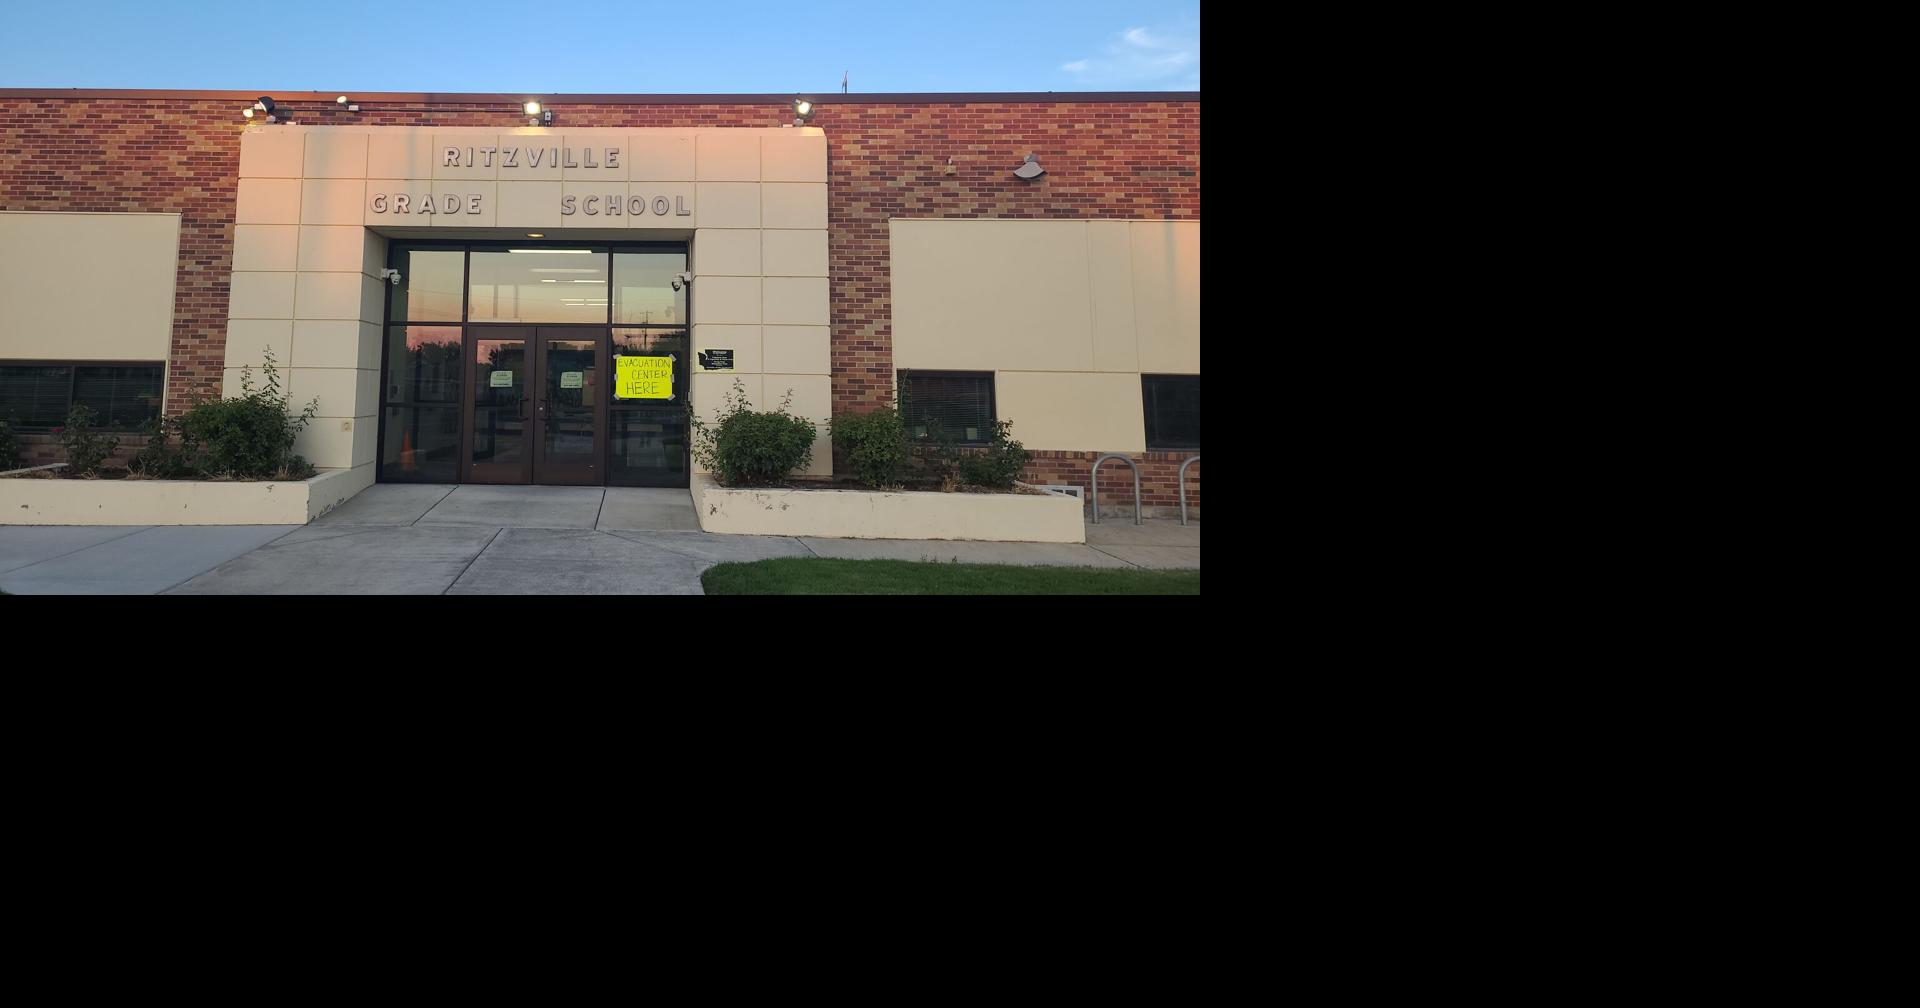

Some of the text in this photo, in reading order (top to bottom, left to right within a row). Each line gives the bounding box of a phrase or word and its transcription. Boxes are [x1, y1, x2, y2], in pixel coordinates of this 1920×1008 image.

[442, 146, 620, 169] RITZVILLE
[370, 193, 692, 217] GRADE SCHOOL
[617, 358, 671, 369] EVACUATION
[631, 369, 668, 380] CENTER
[626, 380, 660, 396] HERE
